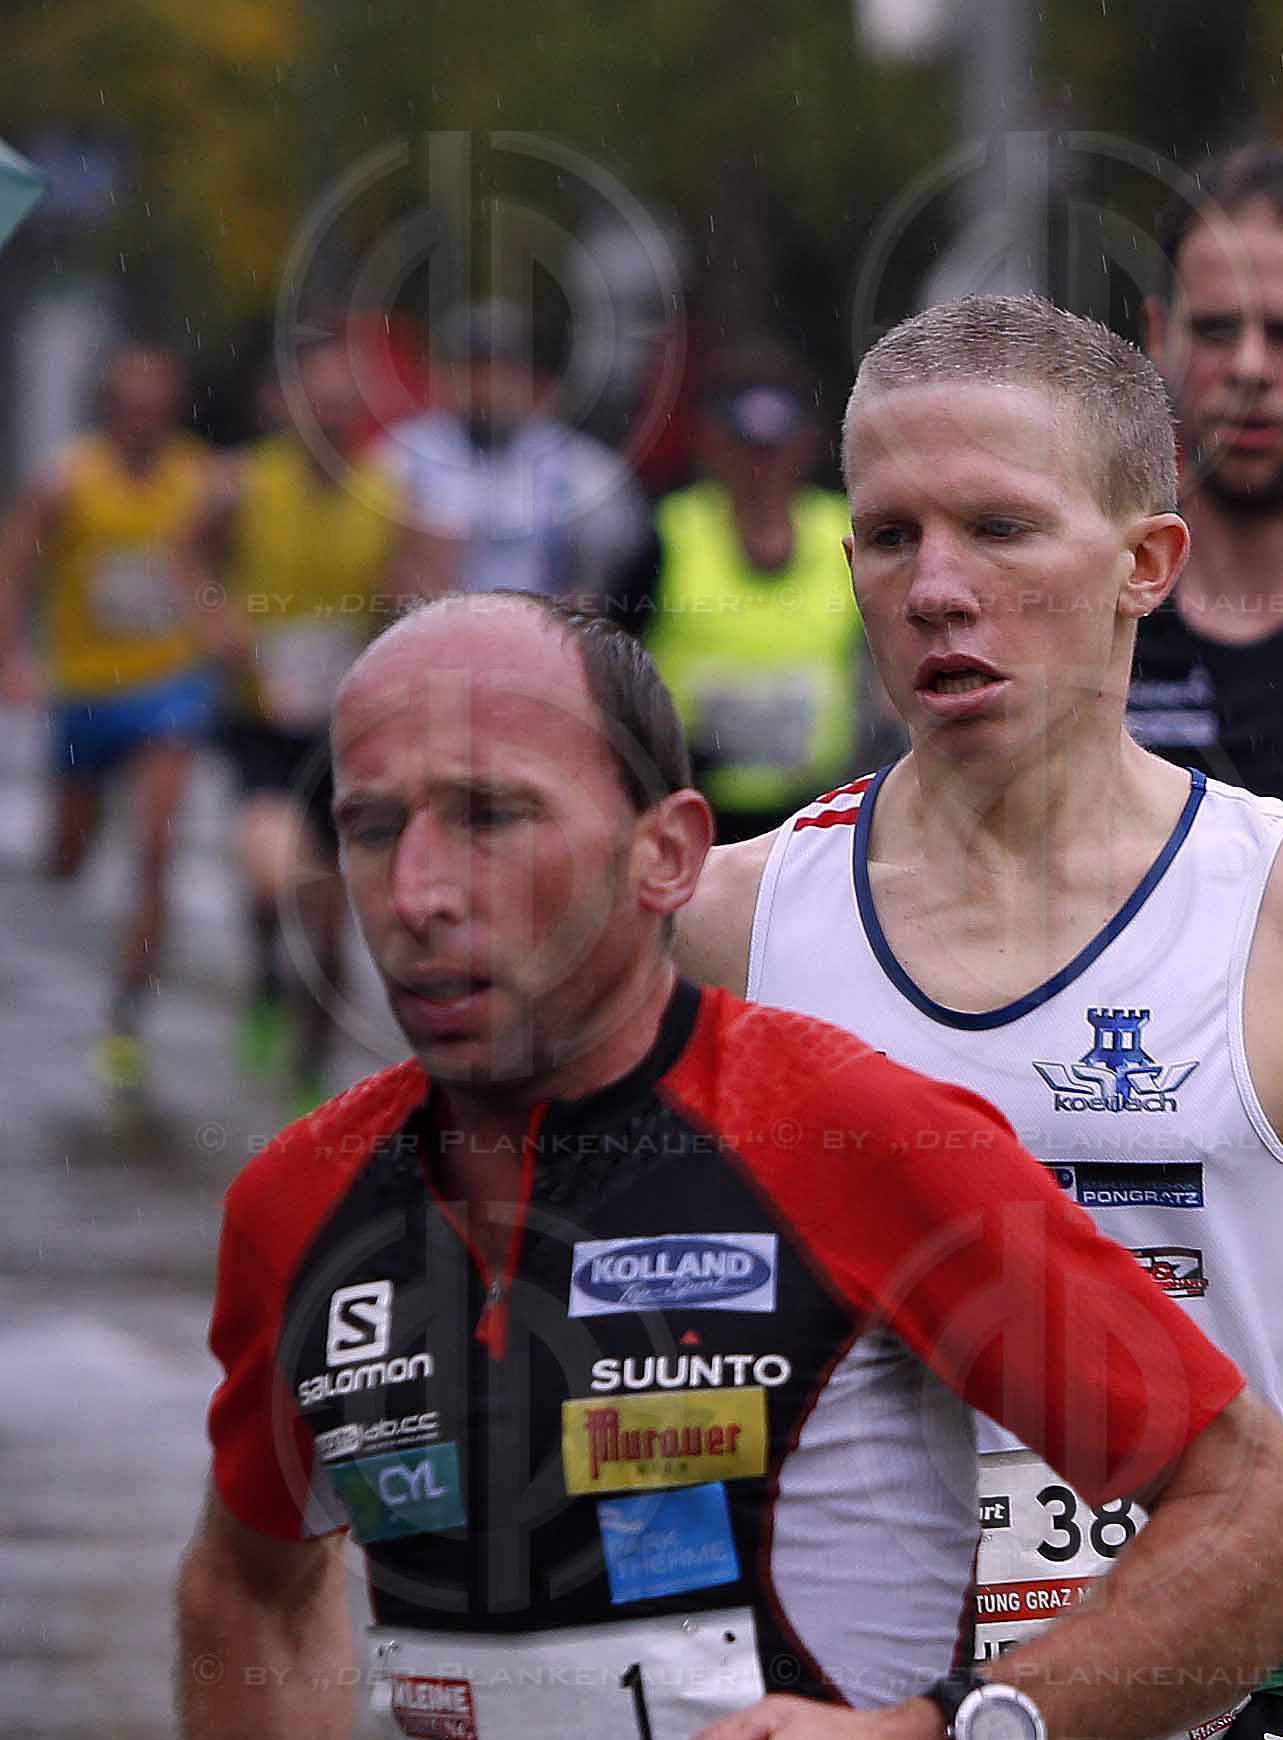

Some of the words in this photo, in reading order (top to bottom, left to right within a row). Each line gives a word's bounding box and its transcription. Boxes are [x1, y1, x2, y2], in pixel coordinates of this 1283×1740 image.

[590, 1250, 753, 1283] KOLLAND
[591, 1354, 791, 1391] SUUNTO
[584, 1408, 742, 1480] Murauer
[1026, 1587, 1071, 1610] GRAZ
